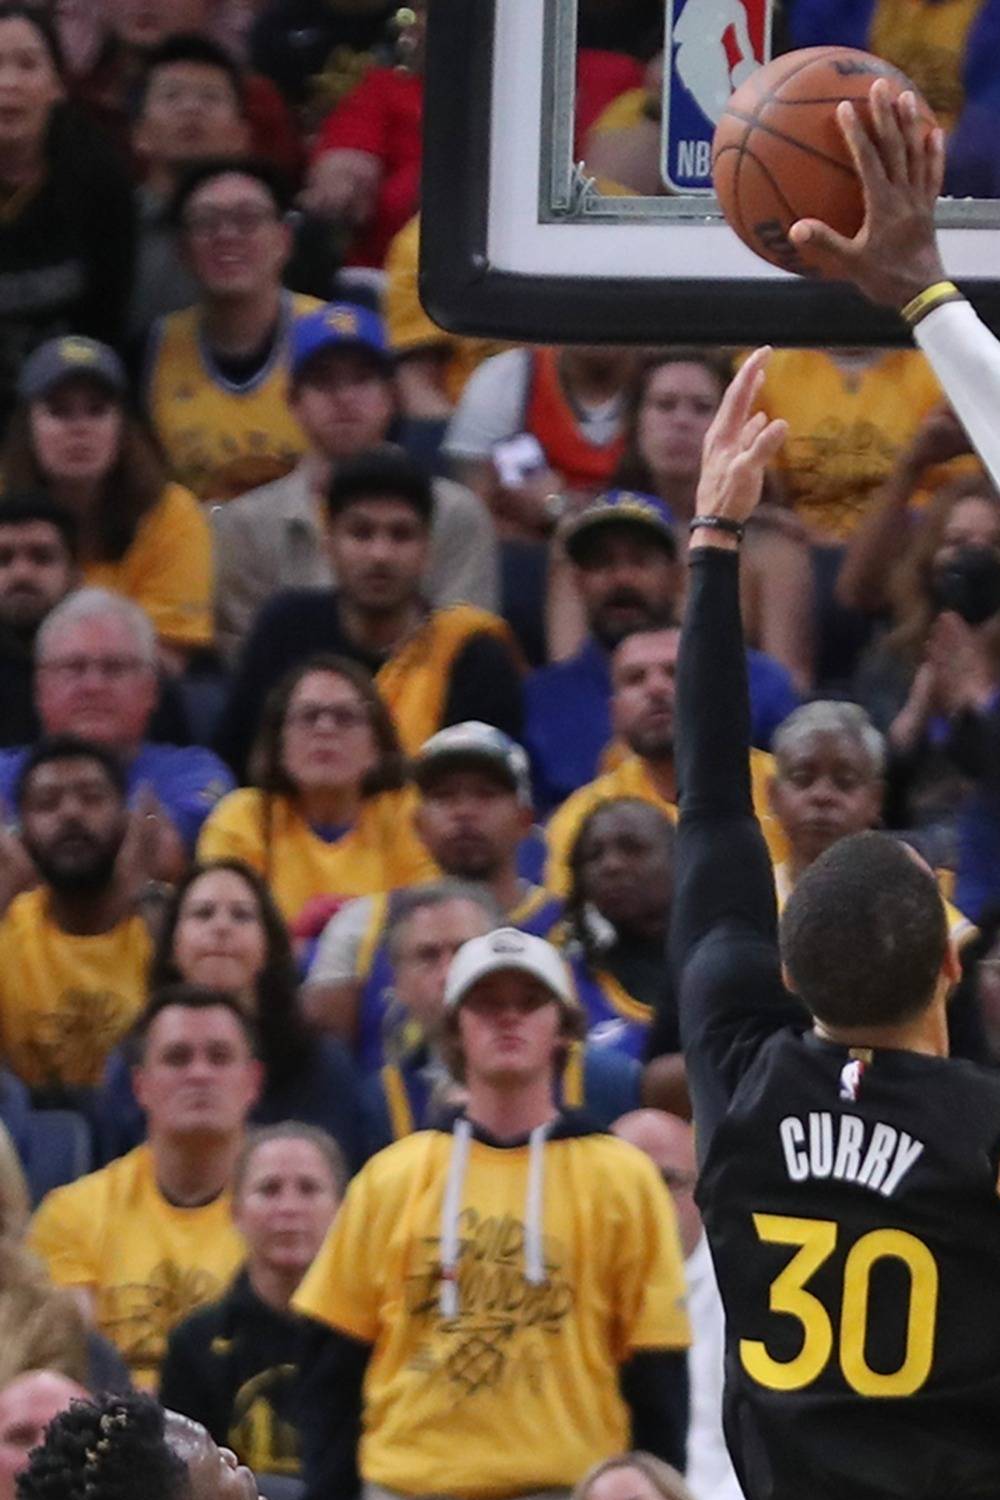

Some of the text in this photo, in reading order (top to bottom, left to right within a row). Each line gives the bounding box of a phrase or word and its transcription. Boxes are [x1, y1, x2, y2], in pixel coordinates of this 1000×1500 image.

[677, 139, 713, 179] NB
[779, 1112, 925, 1197] CURRY
[739, 1211, 939, 1398] 30
